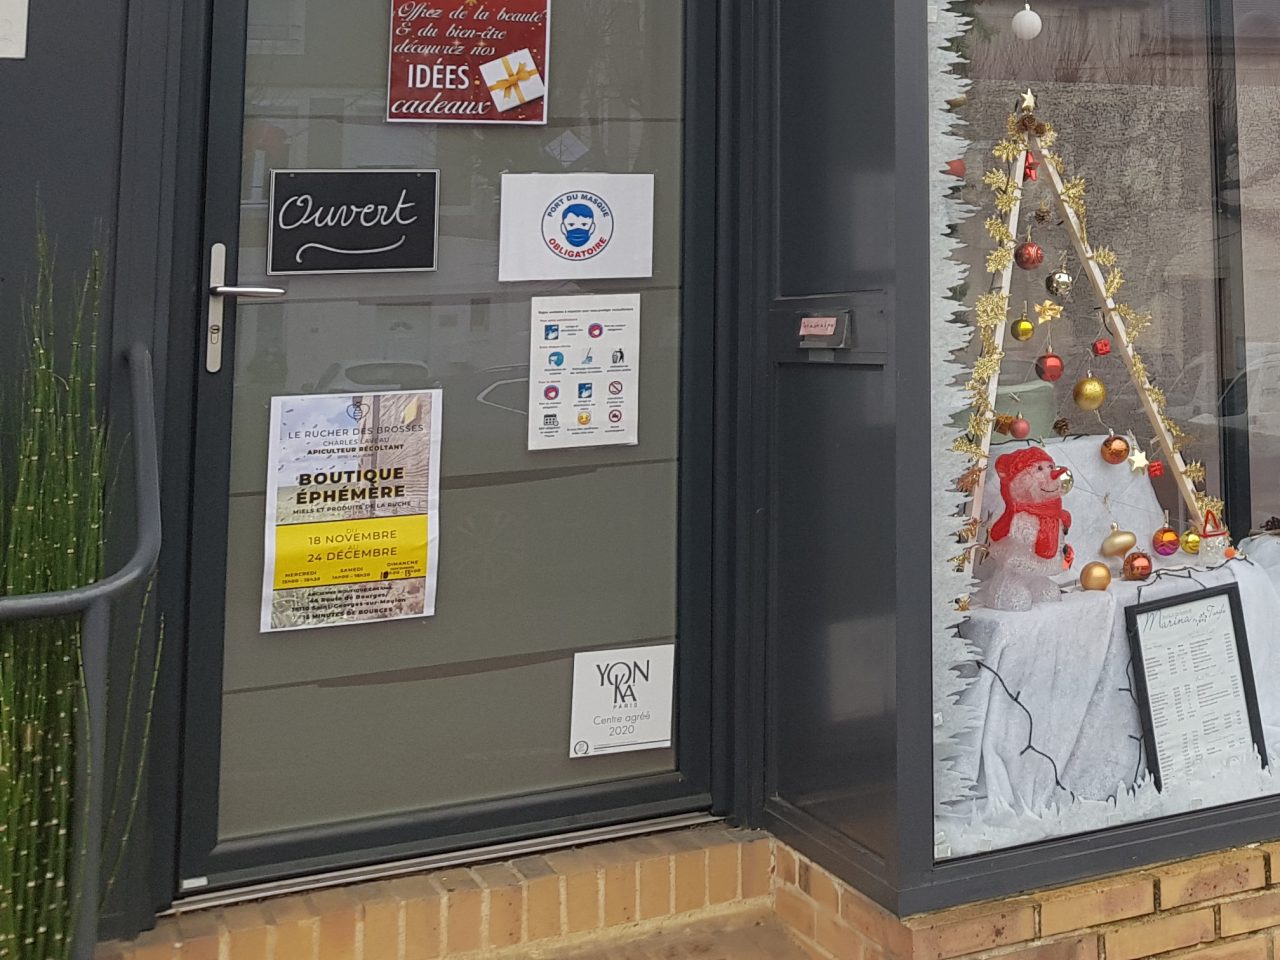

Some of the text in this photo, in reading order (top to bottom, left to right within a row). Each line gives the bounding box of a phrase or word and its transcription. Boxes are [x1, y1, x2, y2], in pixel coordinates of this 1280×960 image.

[398, 0, 548, 23] Offrez de la beauté
[395, 21, 507, 40] & du bien-être
[393, 39, 496, 56] découvrez nos
[407, 58, 470, 90] IDÉES
[391, 92, 491, 115] cadeaux
[279, 189, 418, 229] Ouvert
[547, 194, 610, 218] PORT DU MASQUE
[548, 236, 607, 258] OBLIGATOIRE
[288, 424, 424, 439] LE RUCHER DES BROSSES
[307, 444, 404, 455] APICULTEUR RÉCOLTANT
[322, 439, 358, 447] CHARLES
[299, 467, 404, 486] BOUTIQUE
[296, 483, 405, 505] ÉPHÉMÈRE
[326, 504, 363, 512] PRODUITS
[388, 500, 411, 508] RUCHE
[308, 530, 398, 545] 18 NOVEMBRE
[307, 546, 398, 563] 24 DÉCEMBRE
[593, 711, 651, 726] Centre agréé
[609, 725, 635, 736] 2020
